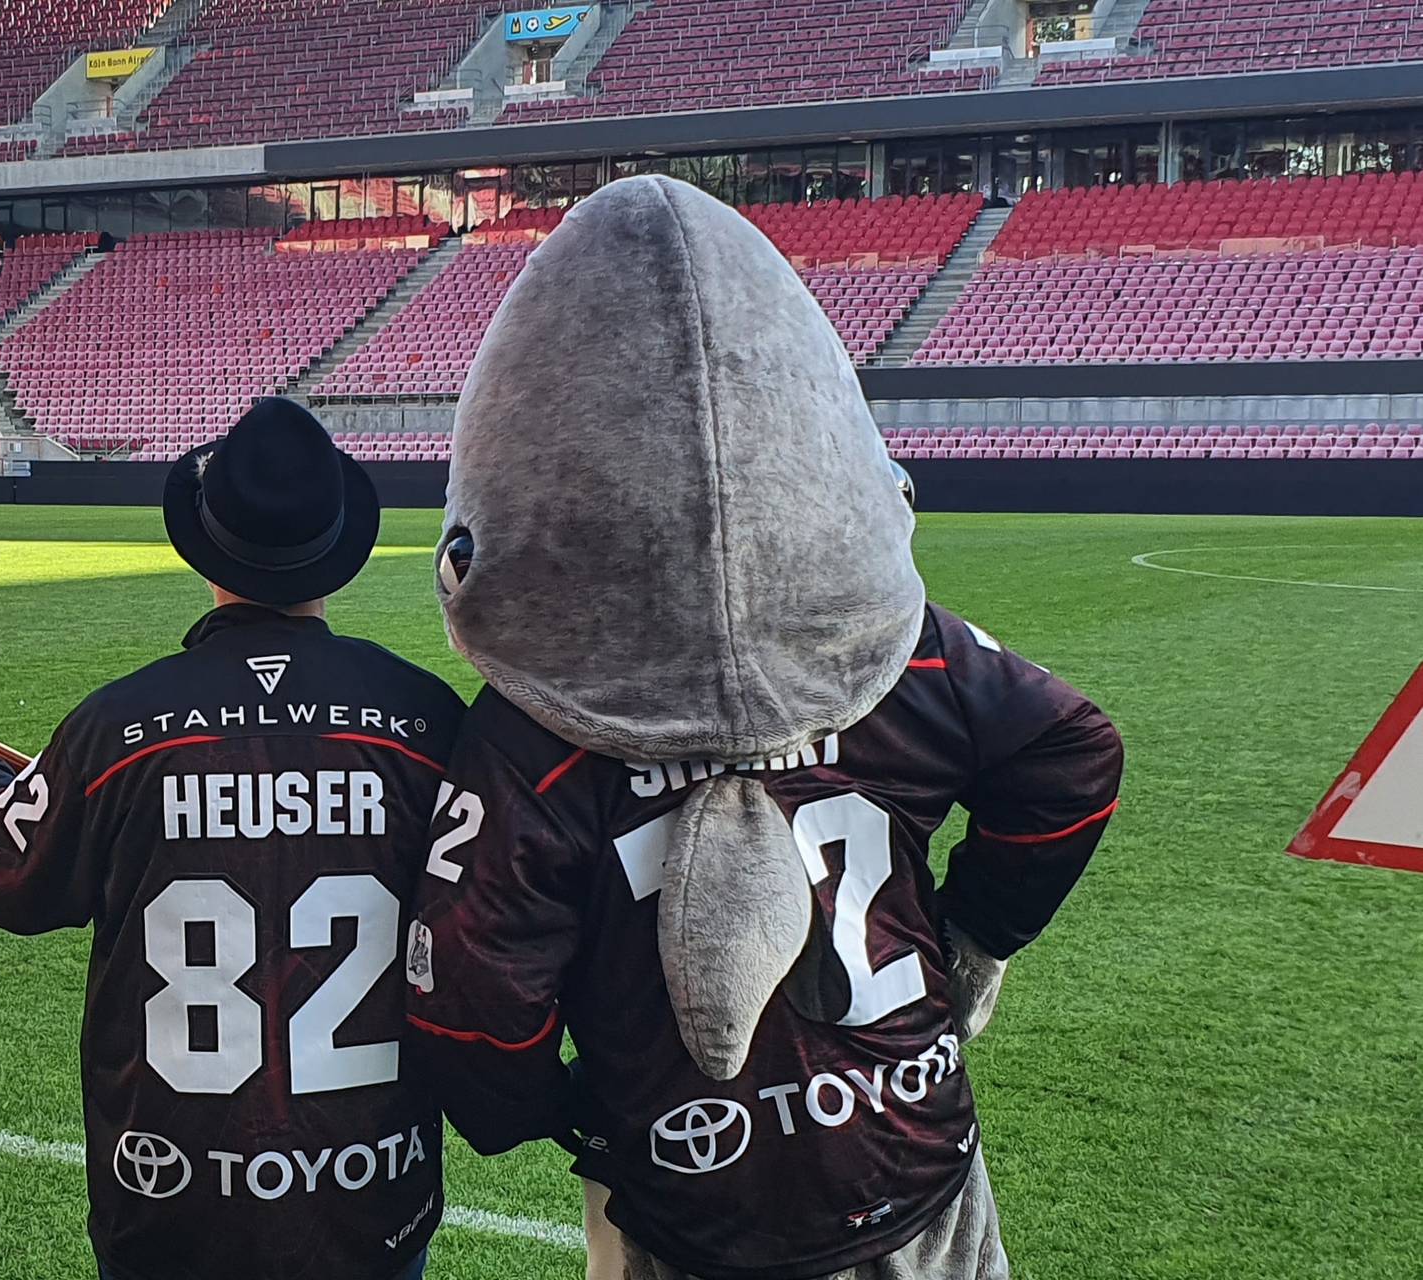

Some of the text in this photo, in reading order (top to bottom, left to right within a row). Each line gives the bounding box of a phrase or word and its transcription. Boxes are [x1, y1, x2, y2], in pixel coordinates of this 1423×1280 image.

[89, 59, 106, 69] Köln
[108, 57, 126, 67] Bonn
[163, 769, 386, 841] HEUSER
[143, 874, 400, 1095] 82
[207, 1124, 426, 1200] TOYOTA
